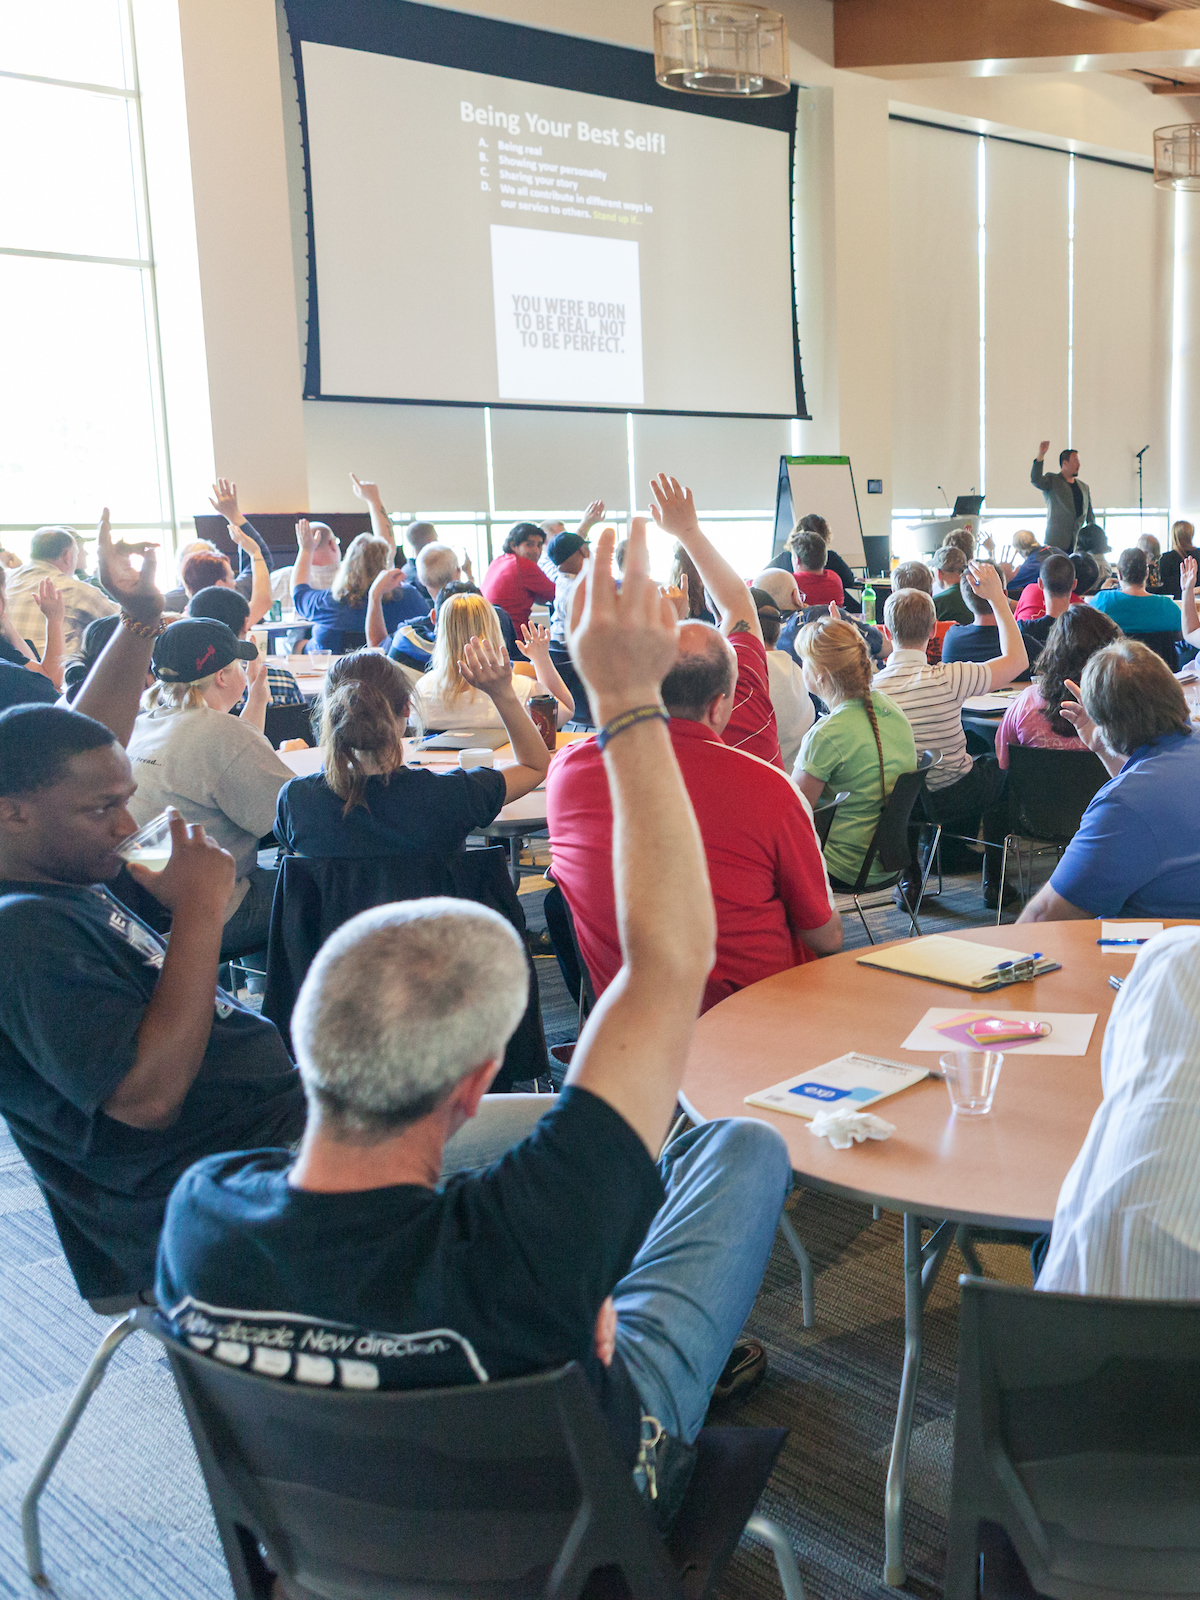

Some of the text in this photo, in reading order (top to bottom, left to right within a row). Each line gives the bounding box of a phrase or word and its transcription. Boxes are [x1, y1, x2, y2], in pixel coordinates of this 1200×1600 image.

[460, 100, 666, 154] Being Your Best Self!
[478, 137, 542, 156] A. Being real
[479, 152, 608, 182] B. Showing your personality
[480, 166, 578, 192] C. Sharing your story
[480, 181, 653, 214] D. We all contribute in different ways in
[500, 199, 517, 209] our
[518, 202, 549, 213] service
[551, 205, 560, 214] to
[562, 207, 592, 219] others.
[593, 210, 617, 222] Stand
[618, 214, 629, 225] up
[512, 294, 625, 320] YOU WERE BORN
[513, 312, 626, 338] TO BE REAL, NOT
[520, 330, 625, 354] TO BE PERFECT.
[179, 1311, 214, 1336] New
[300, 1328, 355, 1353] New
